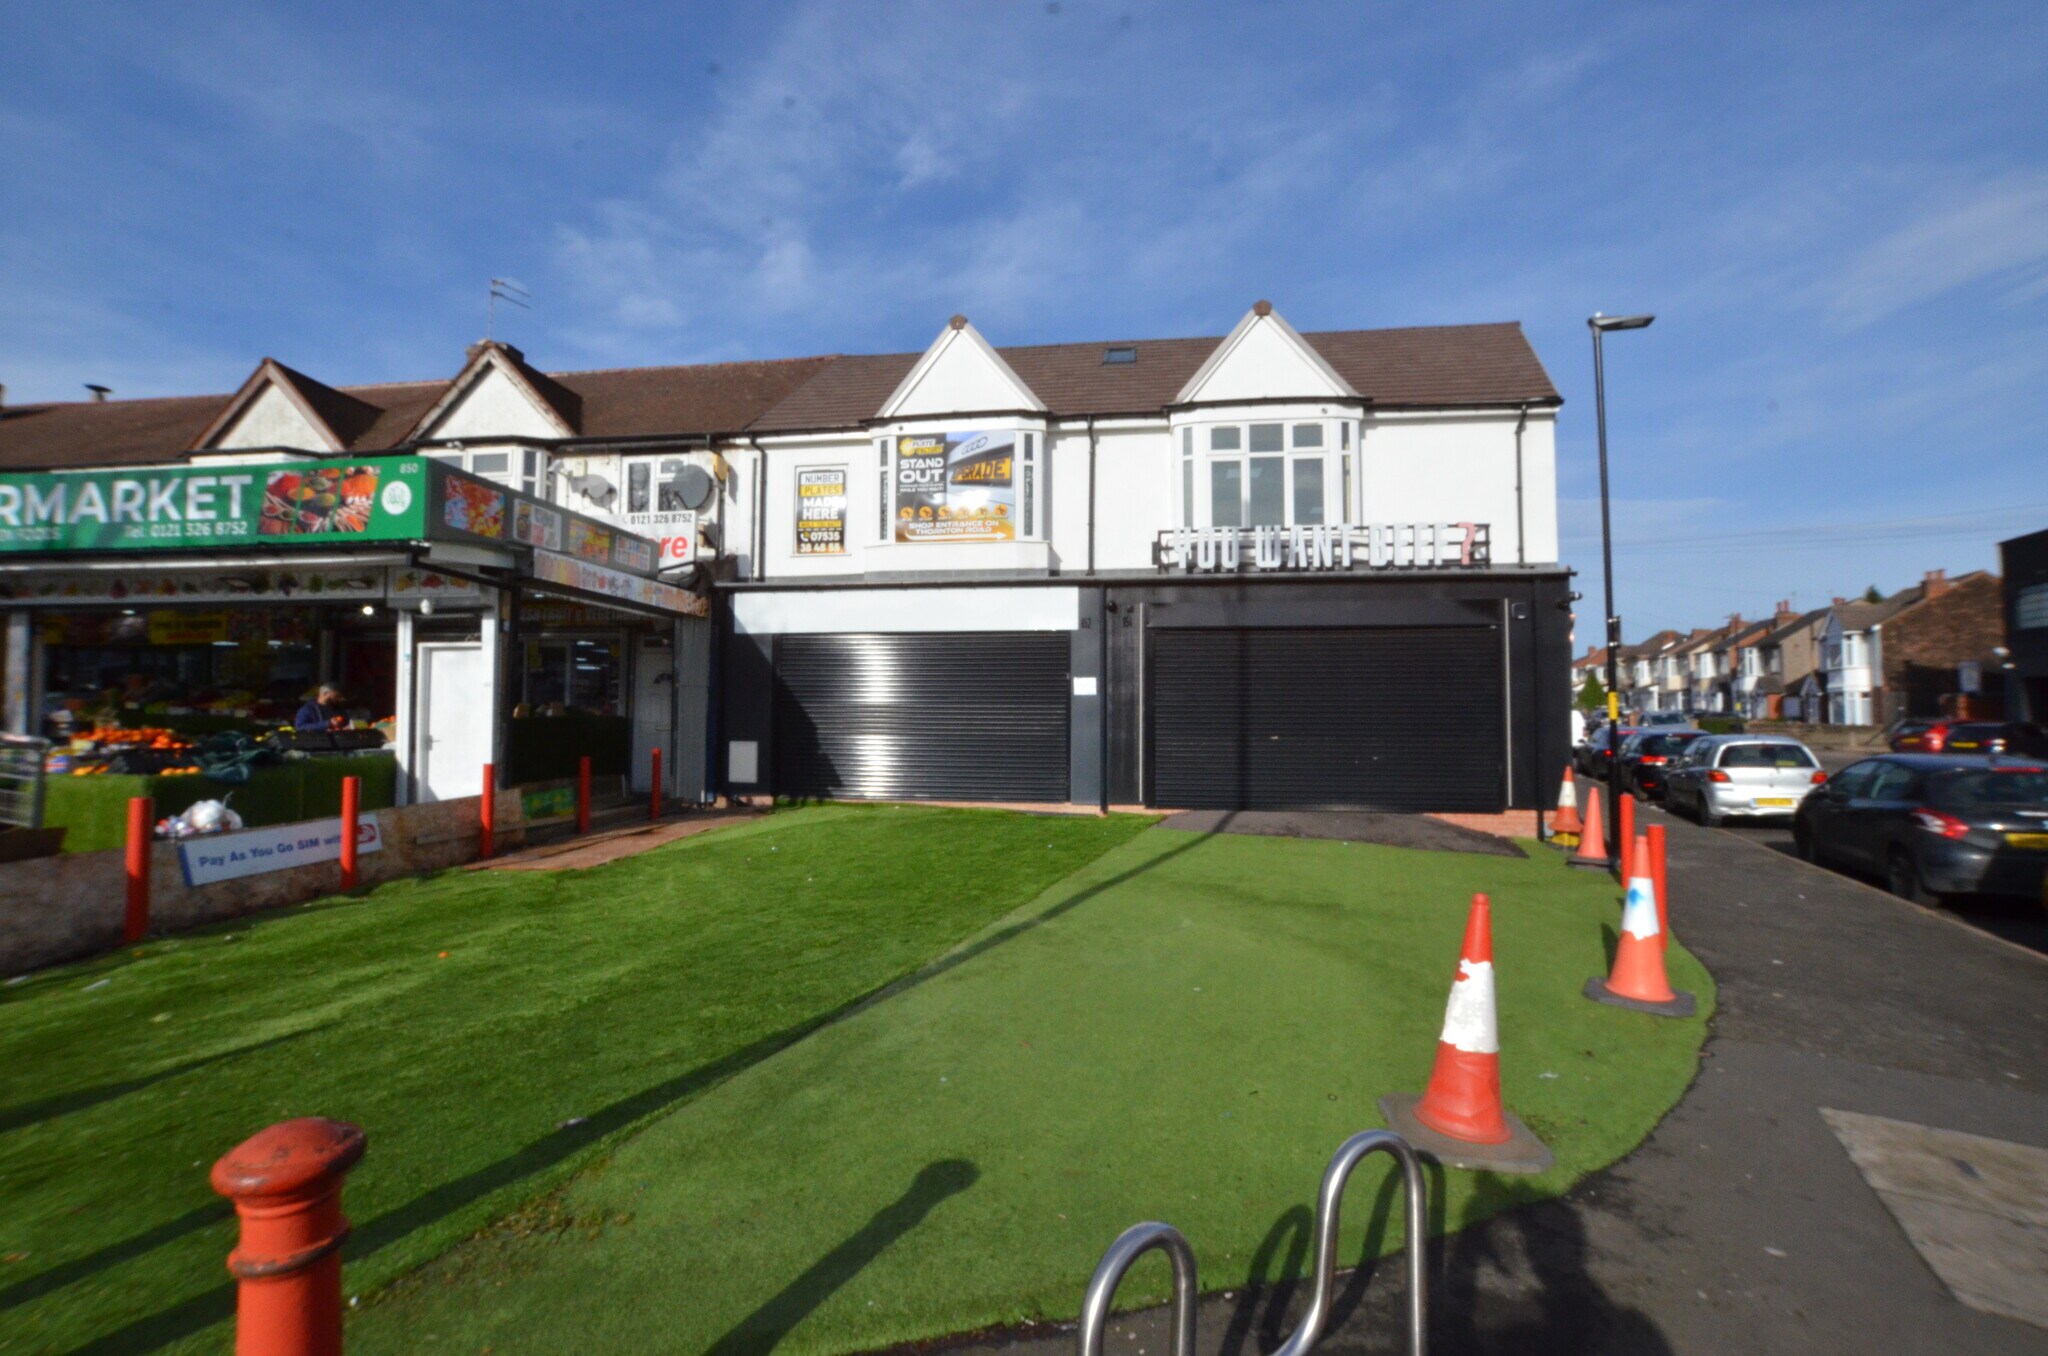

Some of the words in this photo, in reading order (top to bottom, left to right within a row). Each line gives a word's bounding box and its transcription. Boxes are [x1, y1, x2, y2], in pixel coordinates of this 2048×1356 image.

[900, 458, 944, 469] STAND
[805, 474, 840, 483] NUMBER
[900, 468, 944, 483] OUT
[804, 485, 840, 495] PLATES
[631, 514, 651, 525] 0121
[654, 513, 669, 523] 326
[671, 512, 693, 523] 8752
[803, 508, 838, 520] HERE
[150, 523, 181, 537] 0121
[185, 522, 211, 535] 326
[215, 521, 247, 535] 8752
[810, 531, 840, 542] 07535
[1173, 524, 1240, 569] YOU
[1255, 524, 1354, 568] WANT
[199, 855, 225, 868] Pay
[230, 851, 246, 862] As
[250, 846, 274, 858] You
[277, 843, 294, 854] Go
[297, 837, 320, 851] SIM
